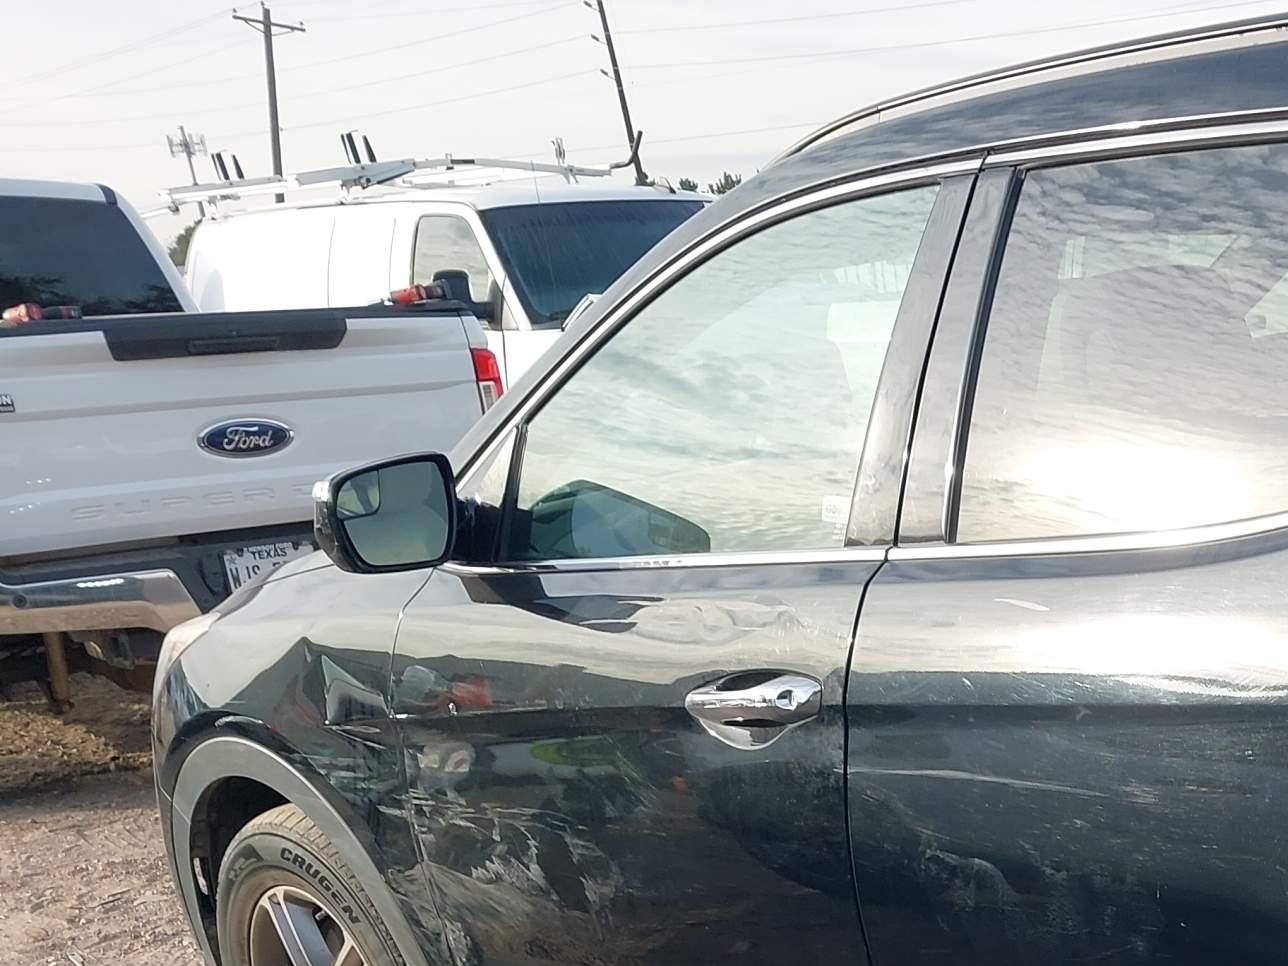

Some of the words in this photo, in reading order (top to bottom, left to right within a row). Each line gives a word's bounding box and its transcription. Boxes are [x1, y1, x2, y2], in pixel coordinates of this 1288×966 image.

[223, 426, 274, 450] Ford
[74, 488, 274, 519] SUPER
[250, 546, 288, 560] TEXAS
[280, 847, 361, 925] CRUGEN
